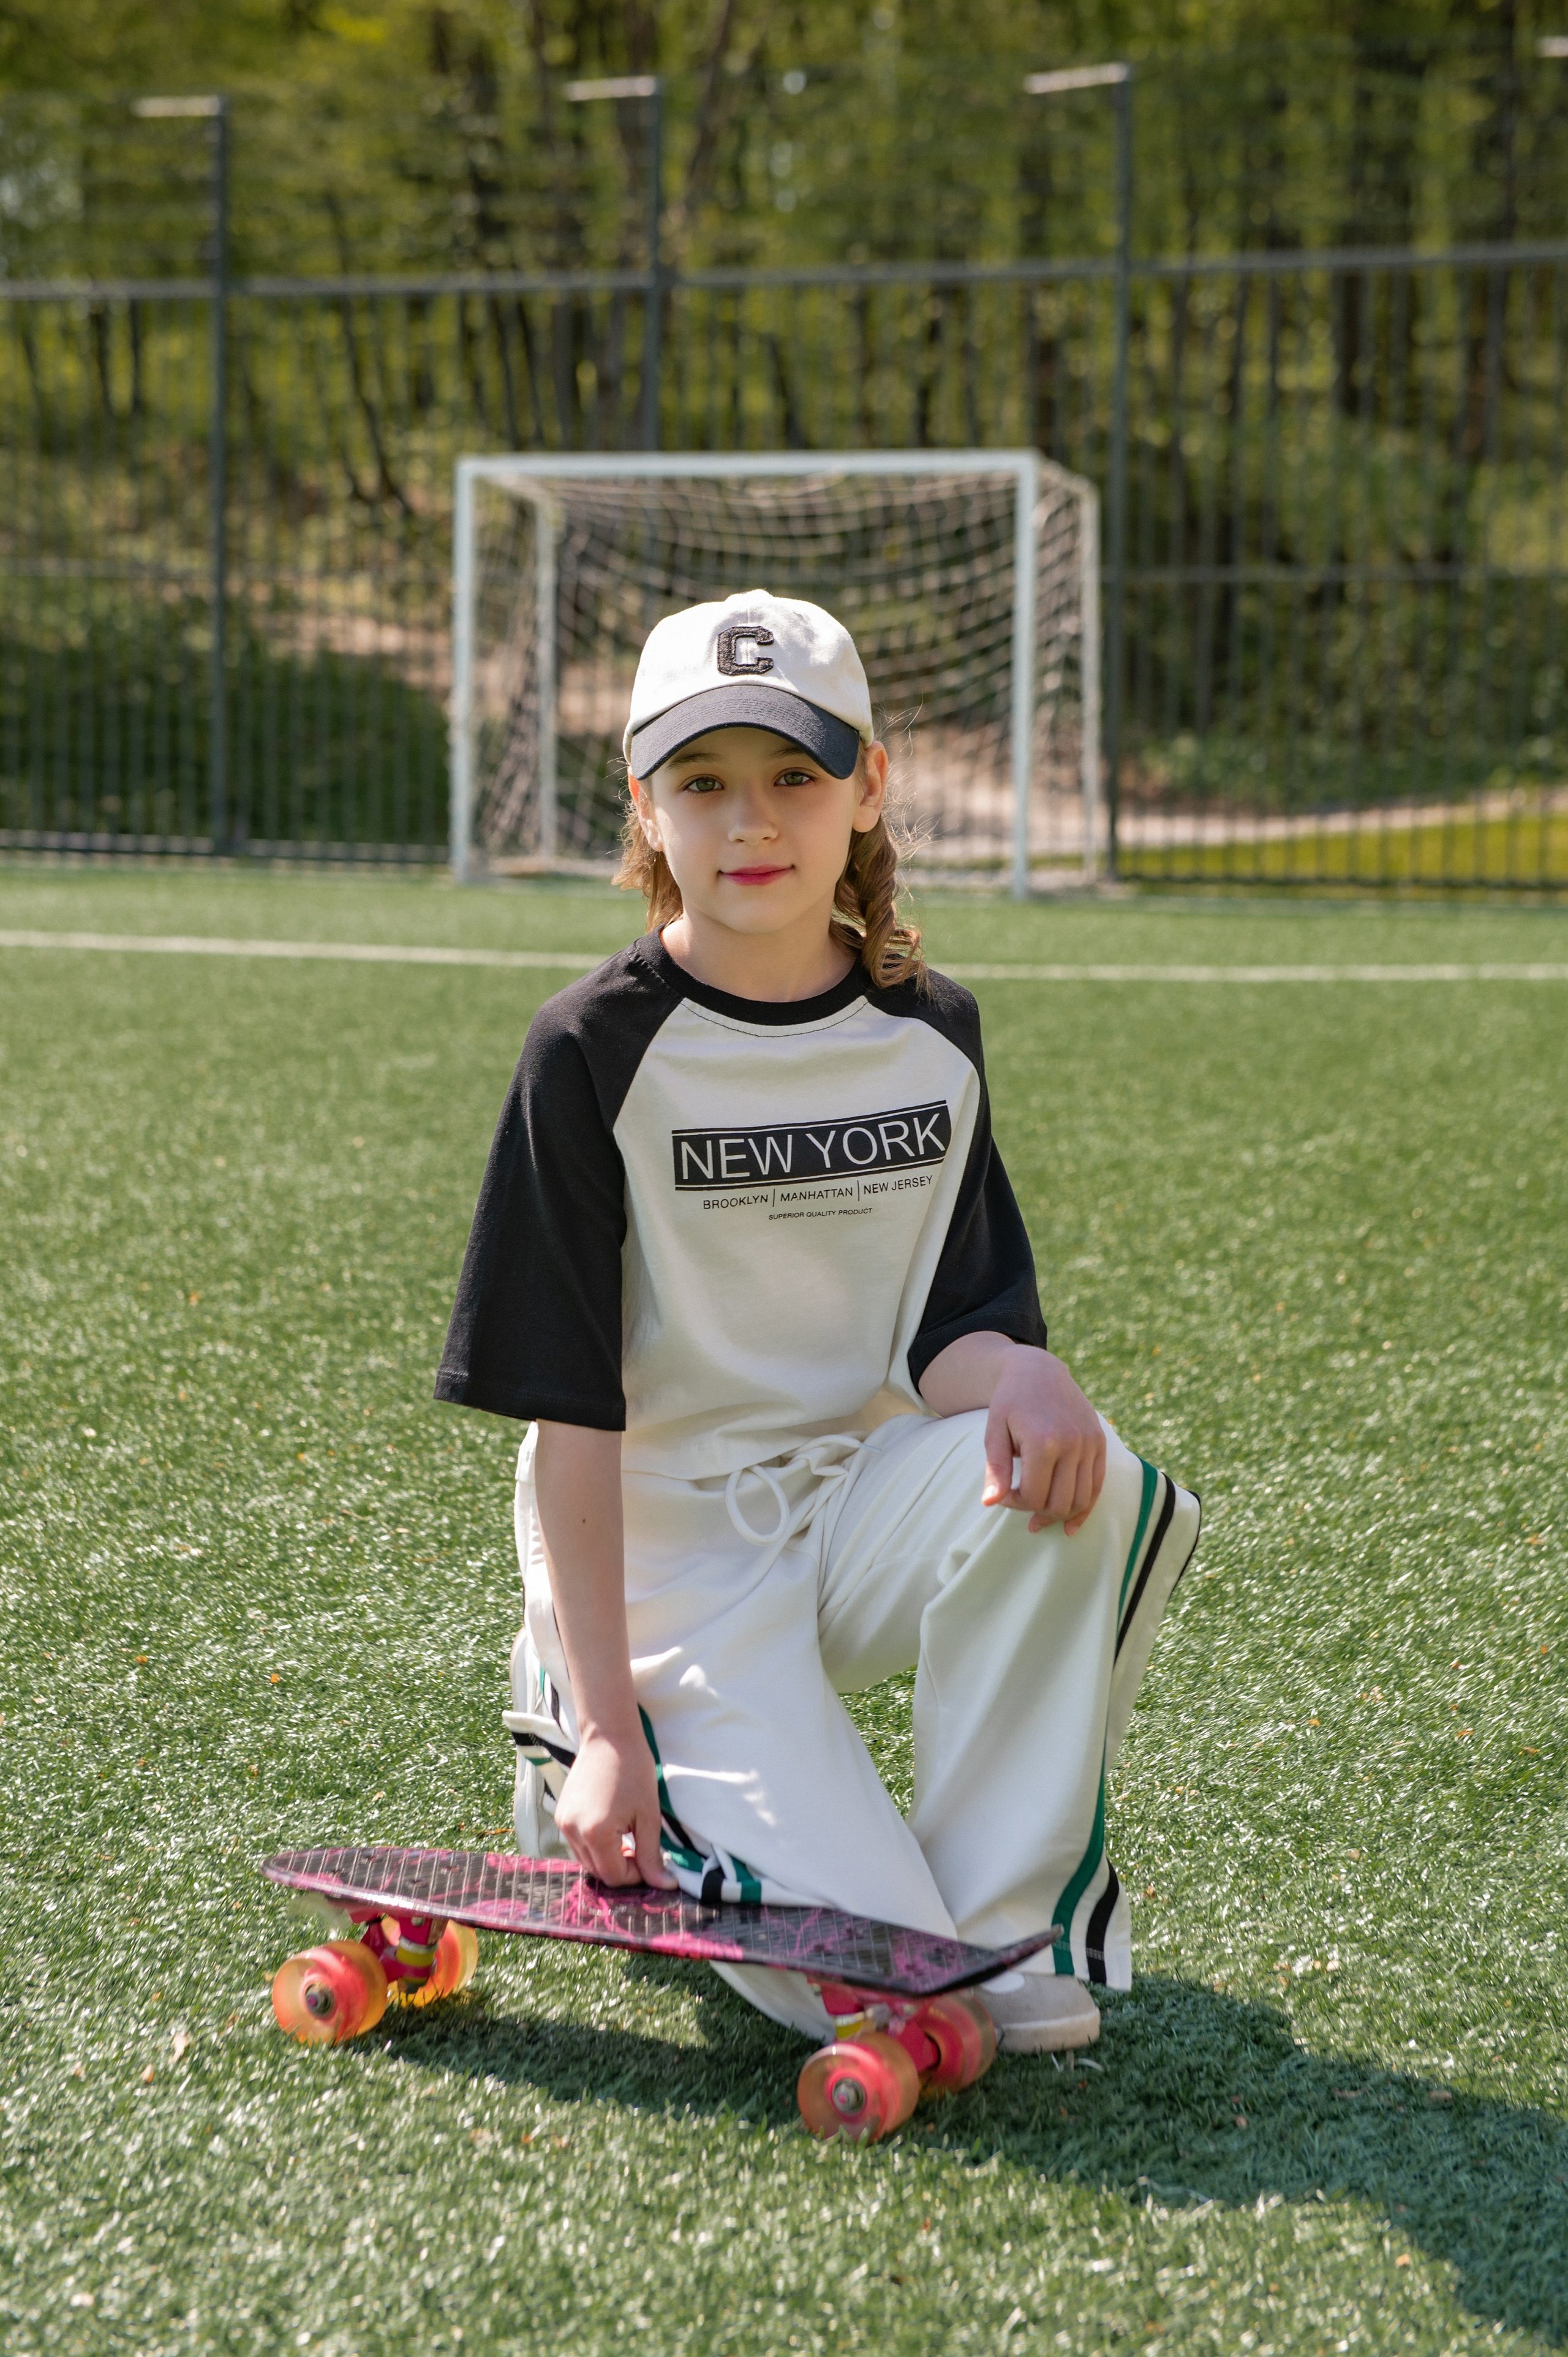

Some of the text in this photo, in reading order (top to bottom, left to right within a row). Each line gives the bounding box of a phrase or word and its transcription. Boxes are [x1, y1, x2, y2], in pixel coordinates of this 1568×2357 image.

[717, 625, 774, 676] C
[680, 1112, 946, 1180] NEW YORK
[703, 1175, 933, 1210] BROOKLYN MANHATTAN NEW JERSEY
[768, 1207, 873, 1220] SUPERIOR QUALITY PRODUCT
